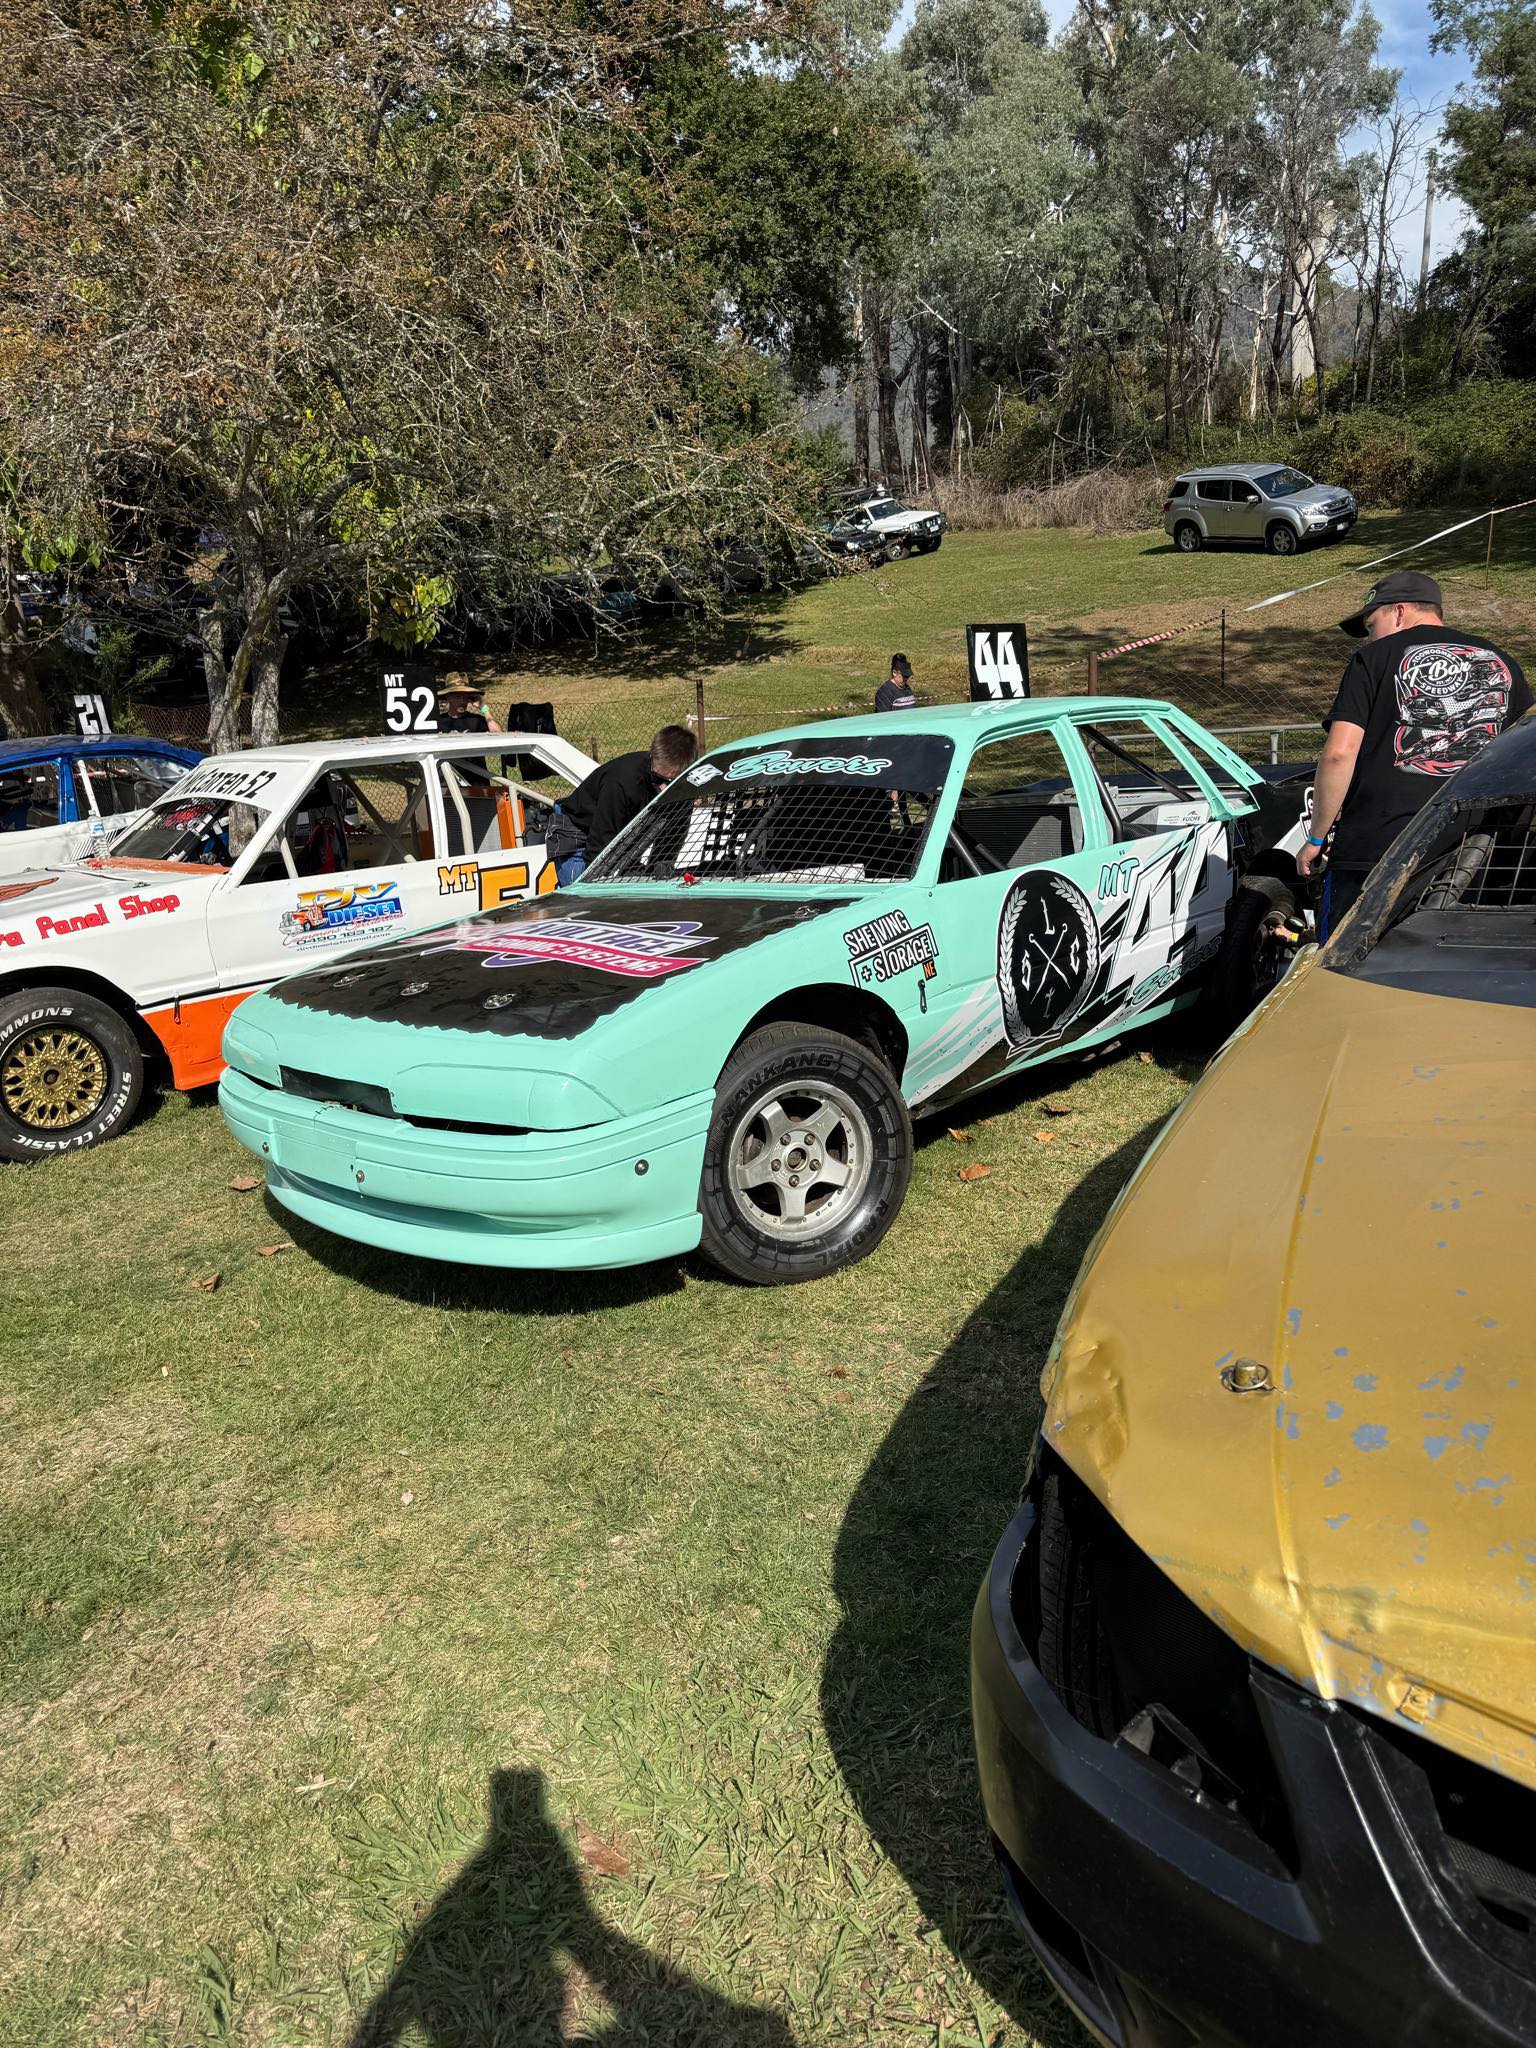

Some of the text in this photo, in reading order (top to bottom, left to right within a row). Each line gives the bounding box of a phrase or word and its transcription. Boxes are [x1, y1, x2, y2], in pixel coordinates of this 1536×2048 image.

[385, 674, 404, 688] MT
[975, 632, 1025, 698] 44
[1420, 677, 1463, 694] SPEEDWAY
[74, 695, 112, 734] 21
[386, 687, 438, 731] 52
[235, 771, 277, 799] 52
[725, 751, 891, 781] Bowers
[438, 862, 478, 895] MT
[36, 903, 110, 940] Panel
[118, 894, 181, 920] Shop
[328, 901, 399, 926] DIESEL
[1098, 821, 1236, 998] MT 44
[296, 934, 337, 946] 0490
[518, 922, 687, 956] VOLTAGE
[844, 911, 911, 955] SHELVING
[564, 944, 674, 972] SYSTEMS
[874, 935, 932, 981] STORAGE
[923, 961, 936, 979] NE
[0, 1007, 74, 1046] MMONS
[721, 1053, 834, 1128] NANKANG
[12, 1072, 132, 1150] STREET CLASSIC
[815, 1199, 889, 1265] RADIAL
